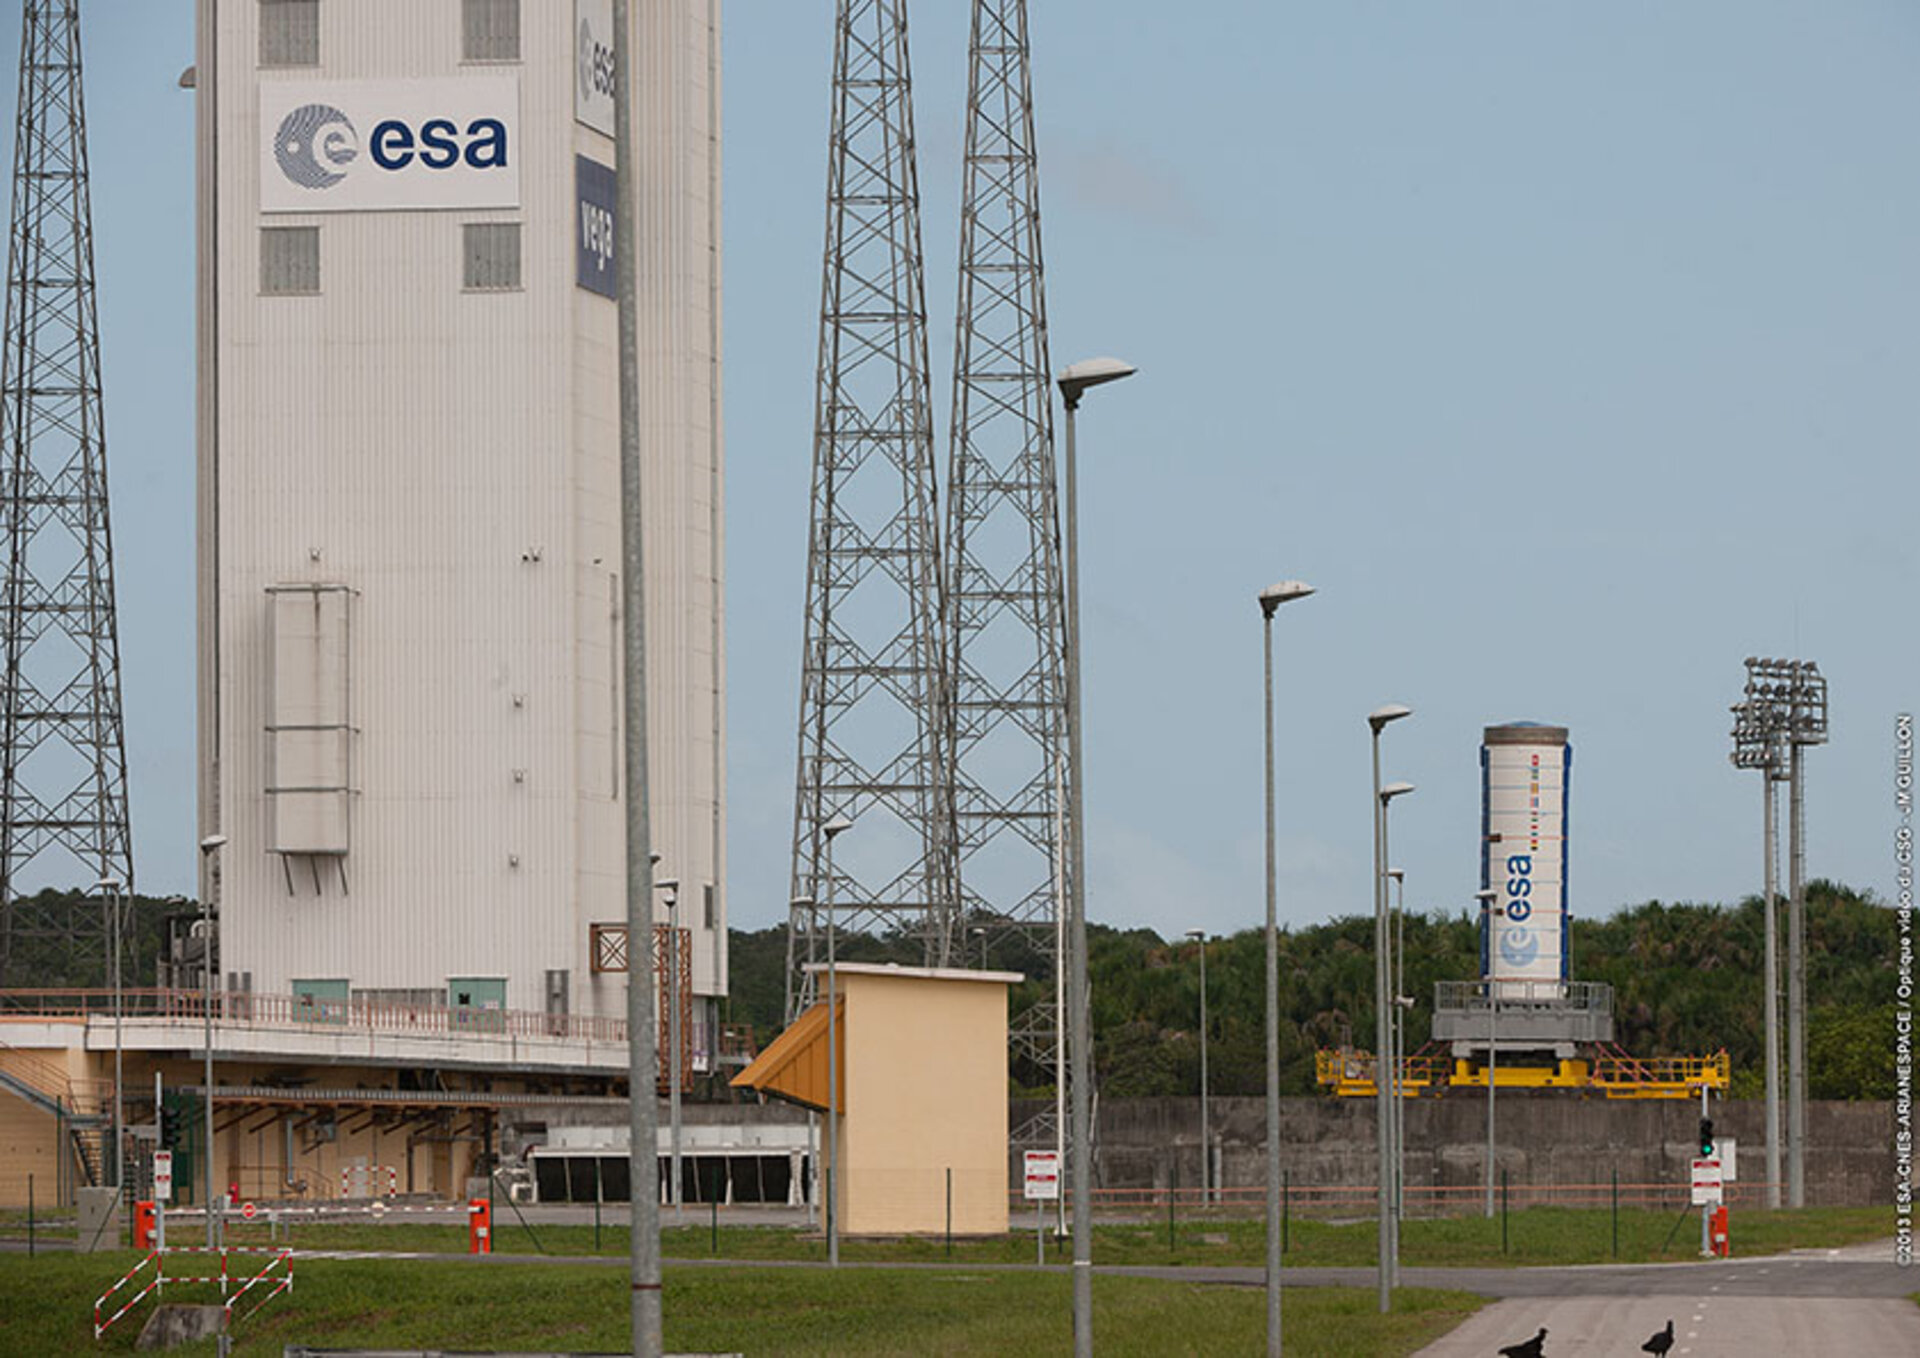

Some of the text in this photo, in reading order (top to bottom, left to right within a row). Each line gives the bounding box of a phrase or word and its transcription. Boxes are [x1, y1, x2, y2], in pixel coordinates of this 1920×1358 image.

[369, 118, 508, 170] esa
[581, 200, 613, 272] vega
[1507, 855, 1532, 922] esa
